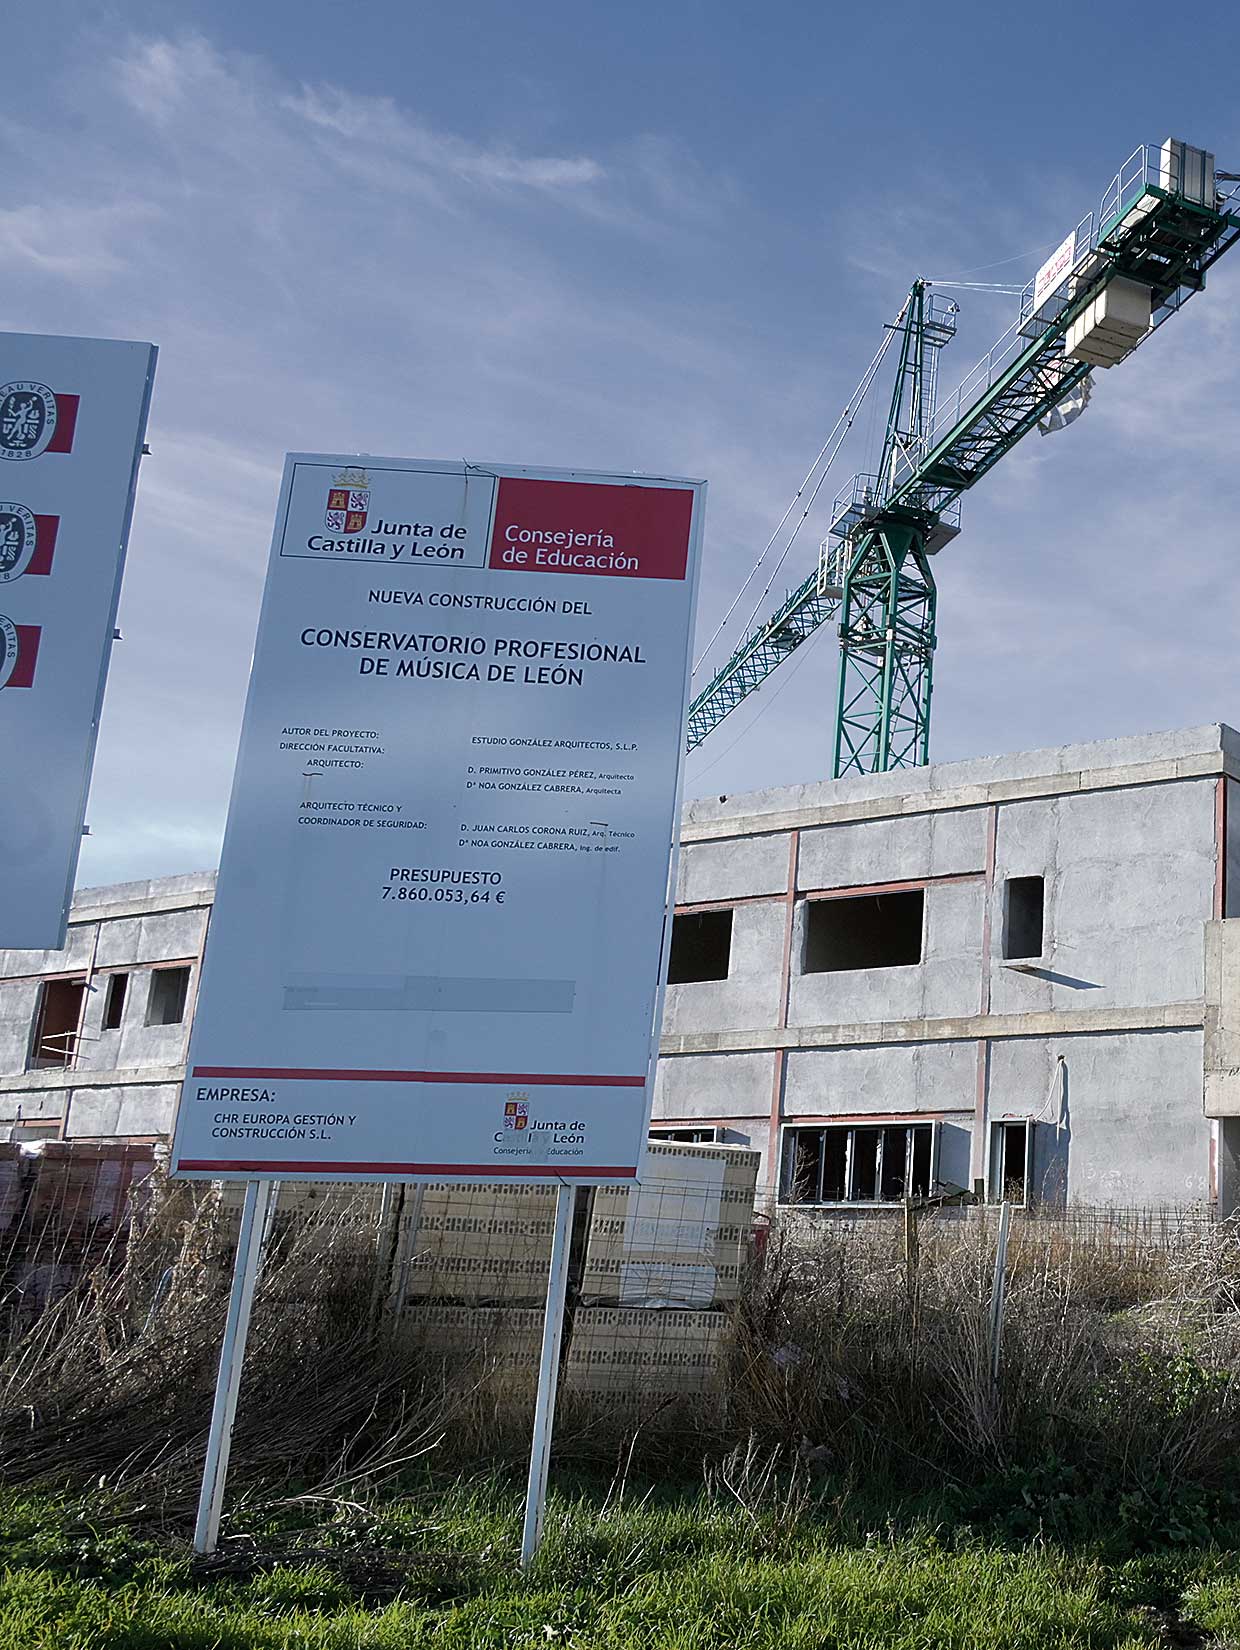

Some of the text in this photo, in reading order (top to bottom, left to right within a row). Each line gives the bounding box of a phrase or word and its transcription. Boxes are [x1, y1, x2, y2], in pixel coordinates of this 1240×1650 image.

[0, 384, 55, 425] EAU VERITAS
[1, 450, 32, 458] 1828
[10, 505, 34, 546] VERITAS
[371, 520, 467, 539] Junta de
[504, 525, 614, 549] Consejería
[307, 535, 465, 560] Castilla y León
[502, 546, 640, 570] de Educación
[368, 589, 593, 615] NUEVA CONSTRUCCIÓN DEL
[301, 628, 646, 664] CONSERVATORIO PROFESIONAL
[359, 656, 584, 686] DE MÚSICA DE LEÓN
[281, 727, 380, 739] AUTOR DEL PROYECTO:
[279, 742, 385, 754] DIRECCIÓN FACULTATIVA:
[472, 736, 638, 751] ESTUDIO GONZÁLEZ ARQUITECTOS, S.L.P.
[306, 759, 364, 769] ARQUITECTO:
[467, 766, 476, 774] D.
[479, 767, 521, 776] PRIMITIVO
[523, 768, 567, 778] GONZÁLEZ
[568, 770, 597, 780] PÉREZ,
[478, 782, 496, 790] NOA
[498, 782, 542, 792] GONZÁLEZ
[544, 784, 584, 794] CABRERA,
[299, 801, 355, 811] ARQUITECTO
[357, 802, 394, 812] TÉCNICO
[298, 817, 428, 830] COORDINADOR DE SEGURIDAD:
[460, 824, 469, 832] D.
[497, 825, 530, 834] CARLOS
[531, 826, 566, 835] CORONA
[568, 828, 590, 837] RUIZ,
[491, 840, 535, 849] GONZÁLEZ
[537, 842, 577, 852] CABRERA,
[390, 868, 502, 885] PRESUPUESTO
[382, 887, 506, 905] 7.860.053,64 €
[196, 1087, 276, 1102] EMPRESA:
[213, 1113, 357, 1126] CHR EUROPA GESTIÓN Y
[530, 1120, 586, 1131] Junta de
[211, 1126, 332, 1140] CONSTRUCCIÓN S.L.
[553, 1133, 585, 1144] León
